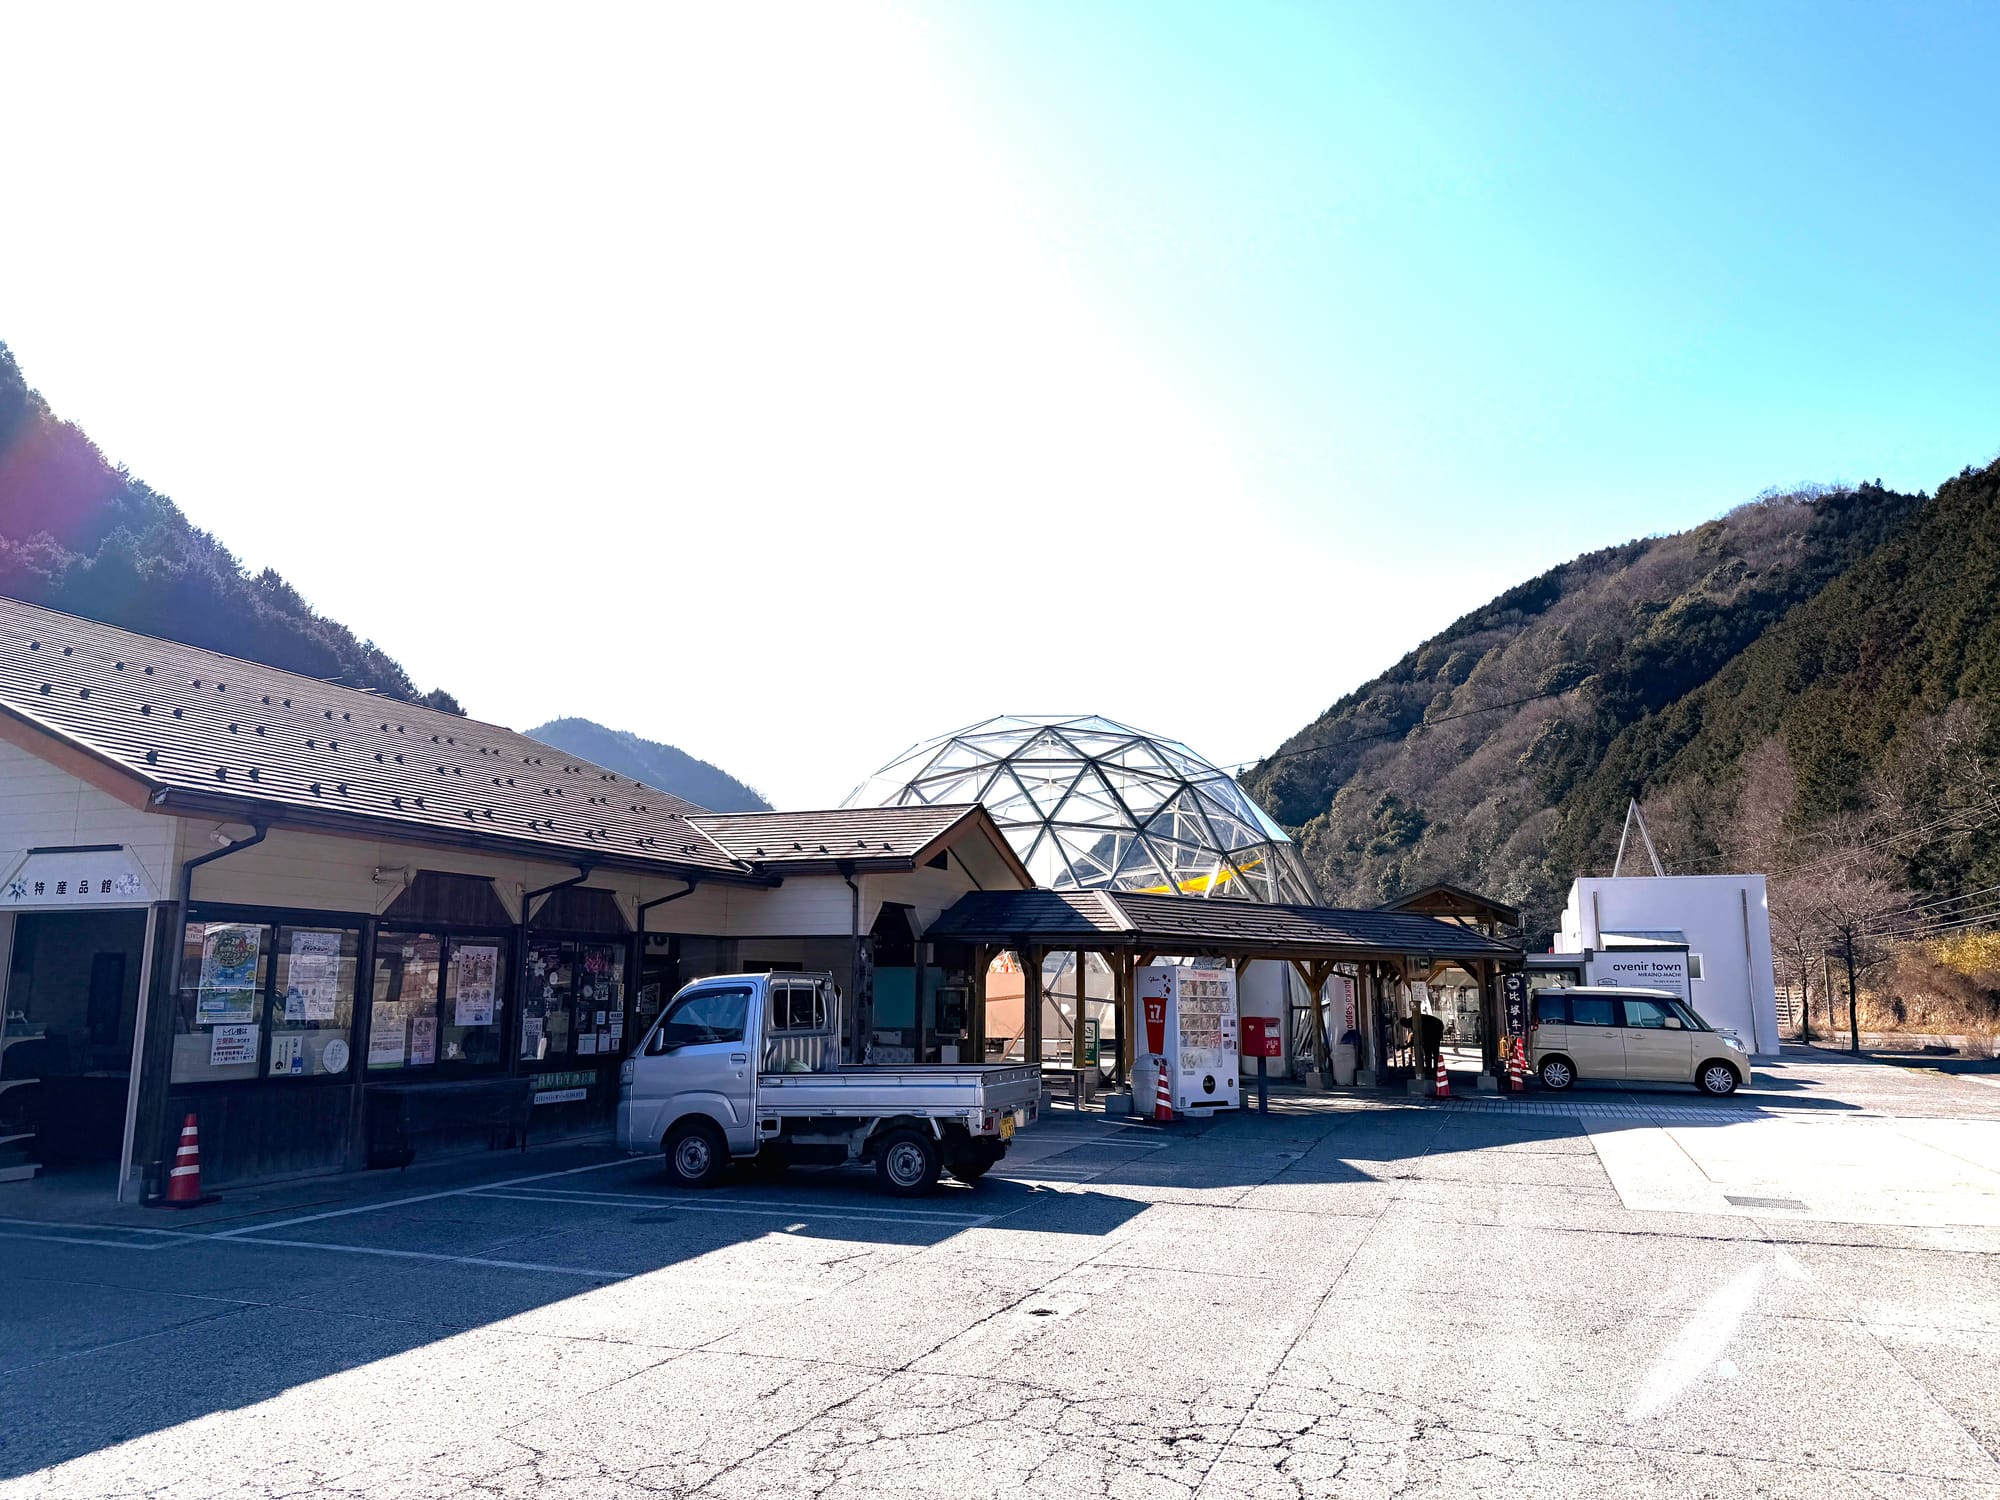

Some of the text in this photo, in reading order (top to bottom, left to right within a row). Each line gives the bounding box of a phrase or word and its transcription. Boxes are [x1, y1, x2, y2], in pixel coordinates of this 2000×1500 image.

[34, 879, 112, 896] 特産品館
[1613, 961, 1681, 971] avenir town
